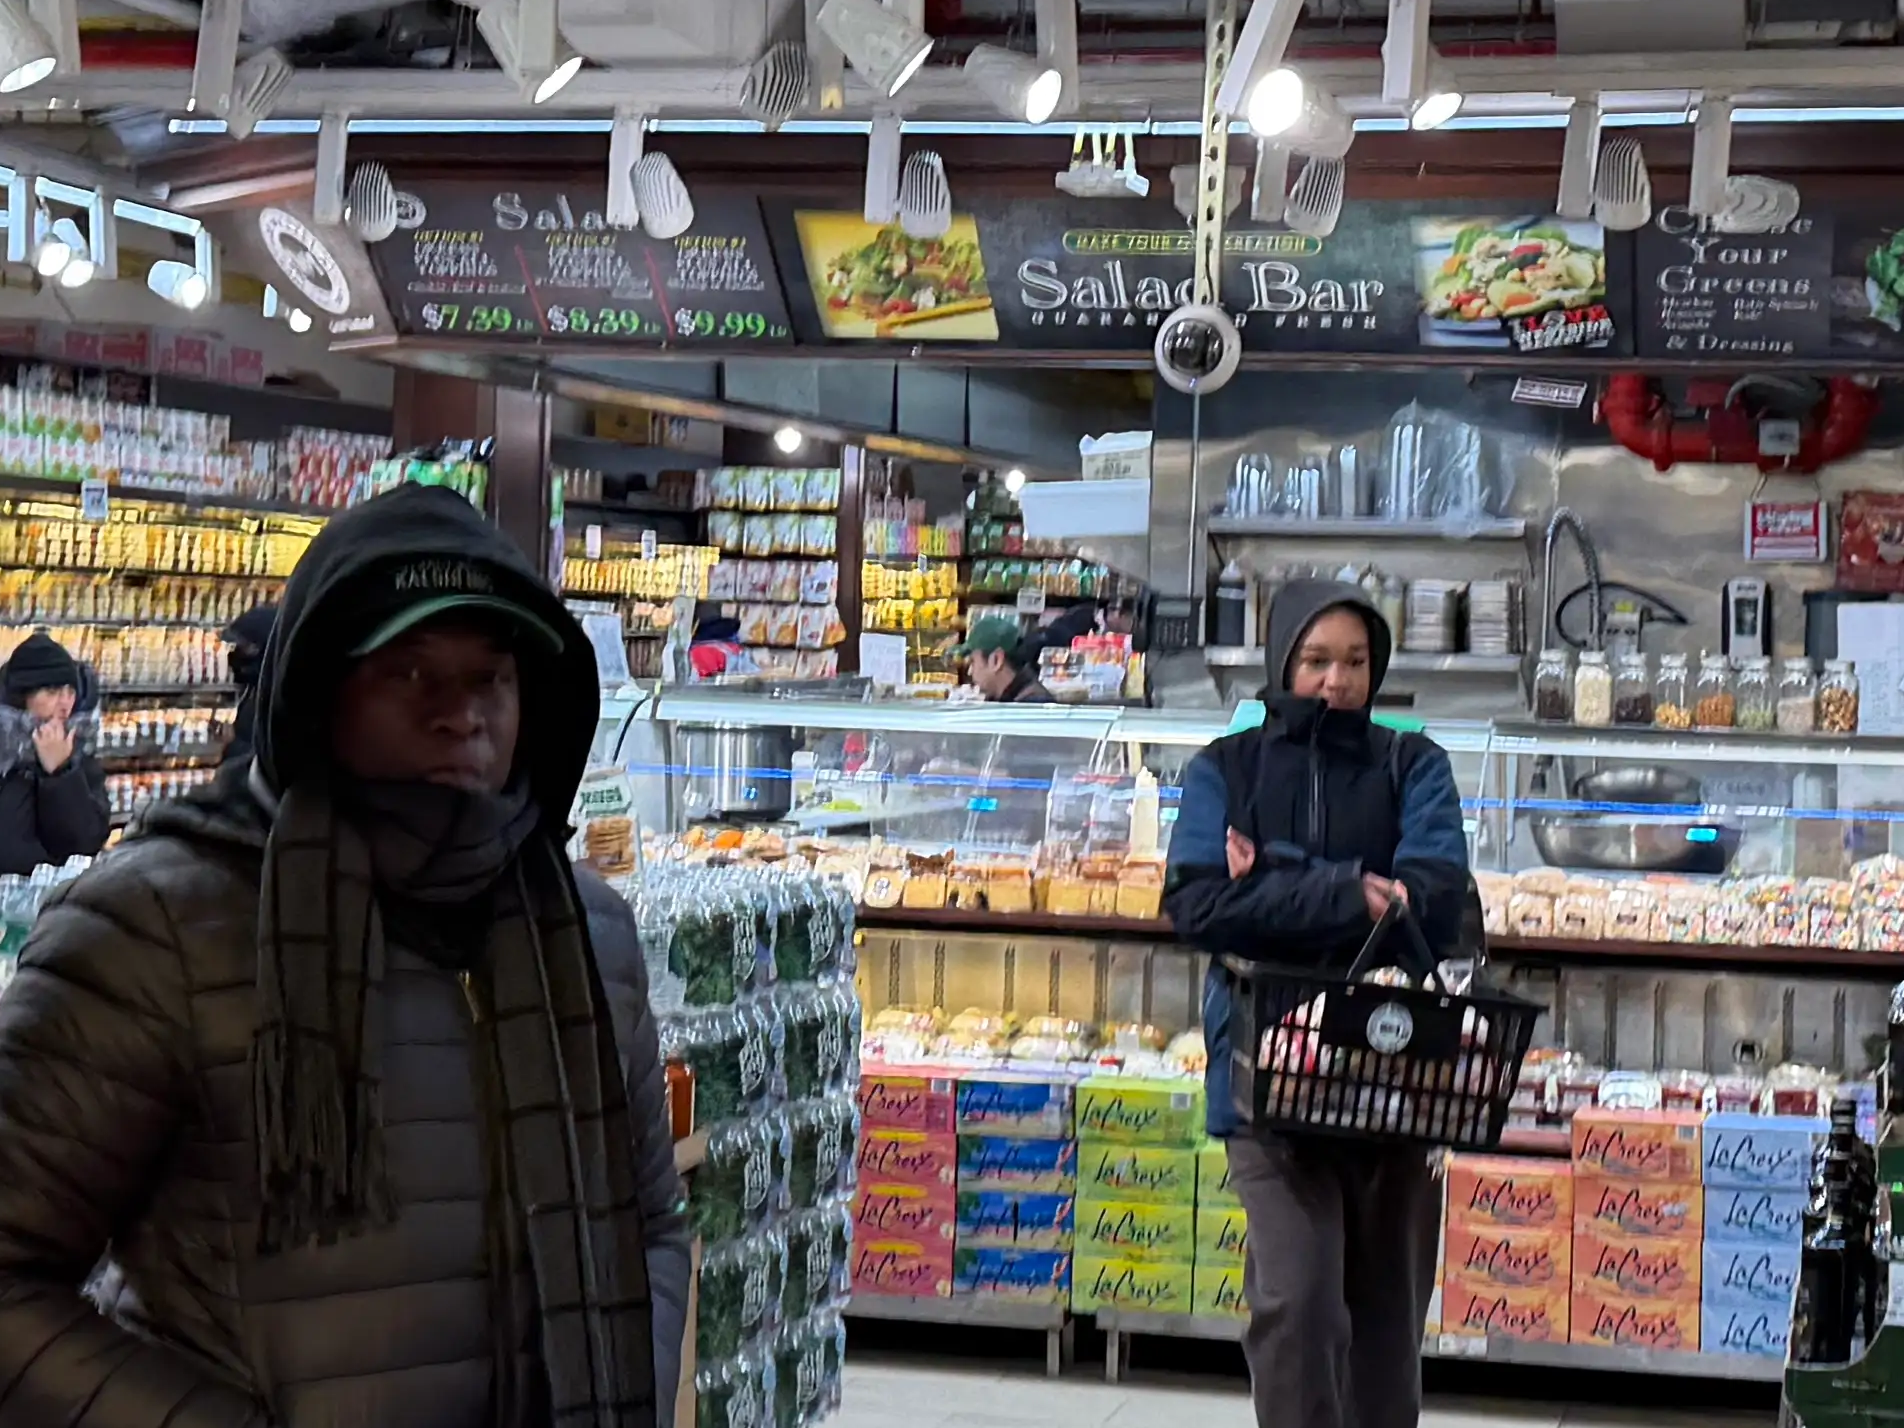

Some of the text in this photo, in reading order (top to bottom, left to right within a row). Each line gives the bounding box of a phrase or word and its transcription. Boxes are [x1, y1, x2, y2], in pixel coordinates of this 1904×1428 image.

[1656, 205, 1814, 234] Chse
[1679, 236, 1789, 265] Your
[1242, 261, 1384, 312] Bar
[1657, 265, 1811, 295] Greens
[856, 1083, 919, 1117] aCroix
[1723, 1192, 1801, 1230] LaCroi
[1721, 1312, 1788, 1352] LaCro
